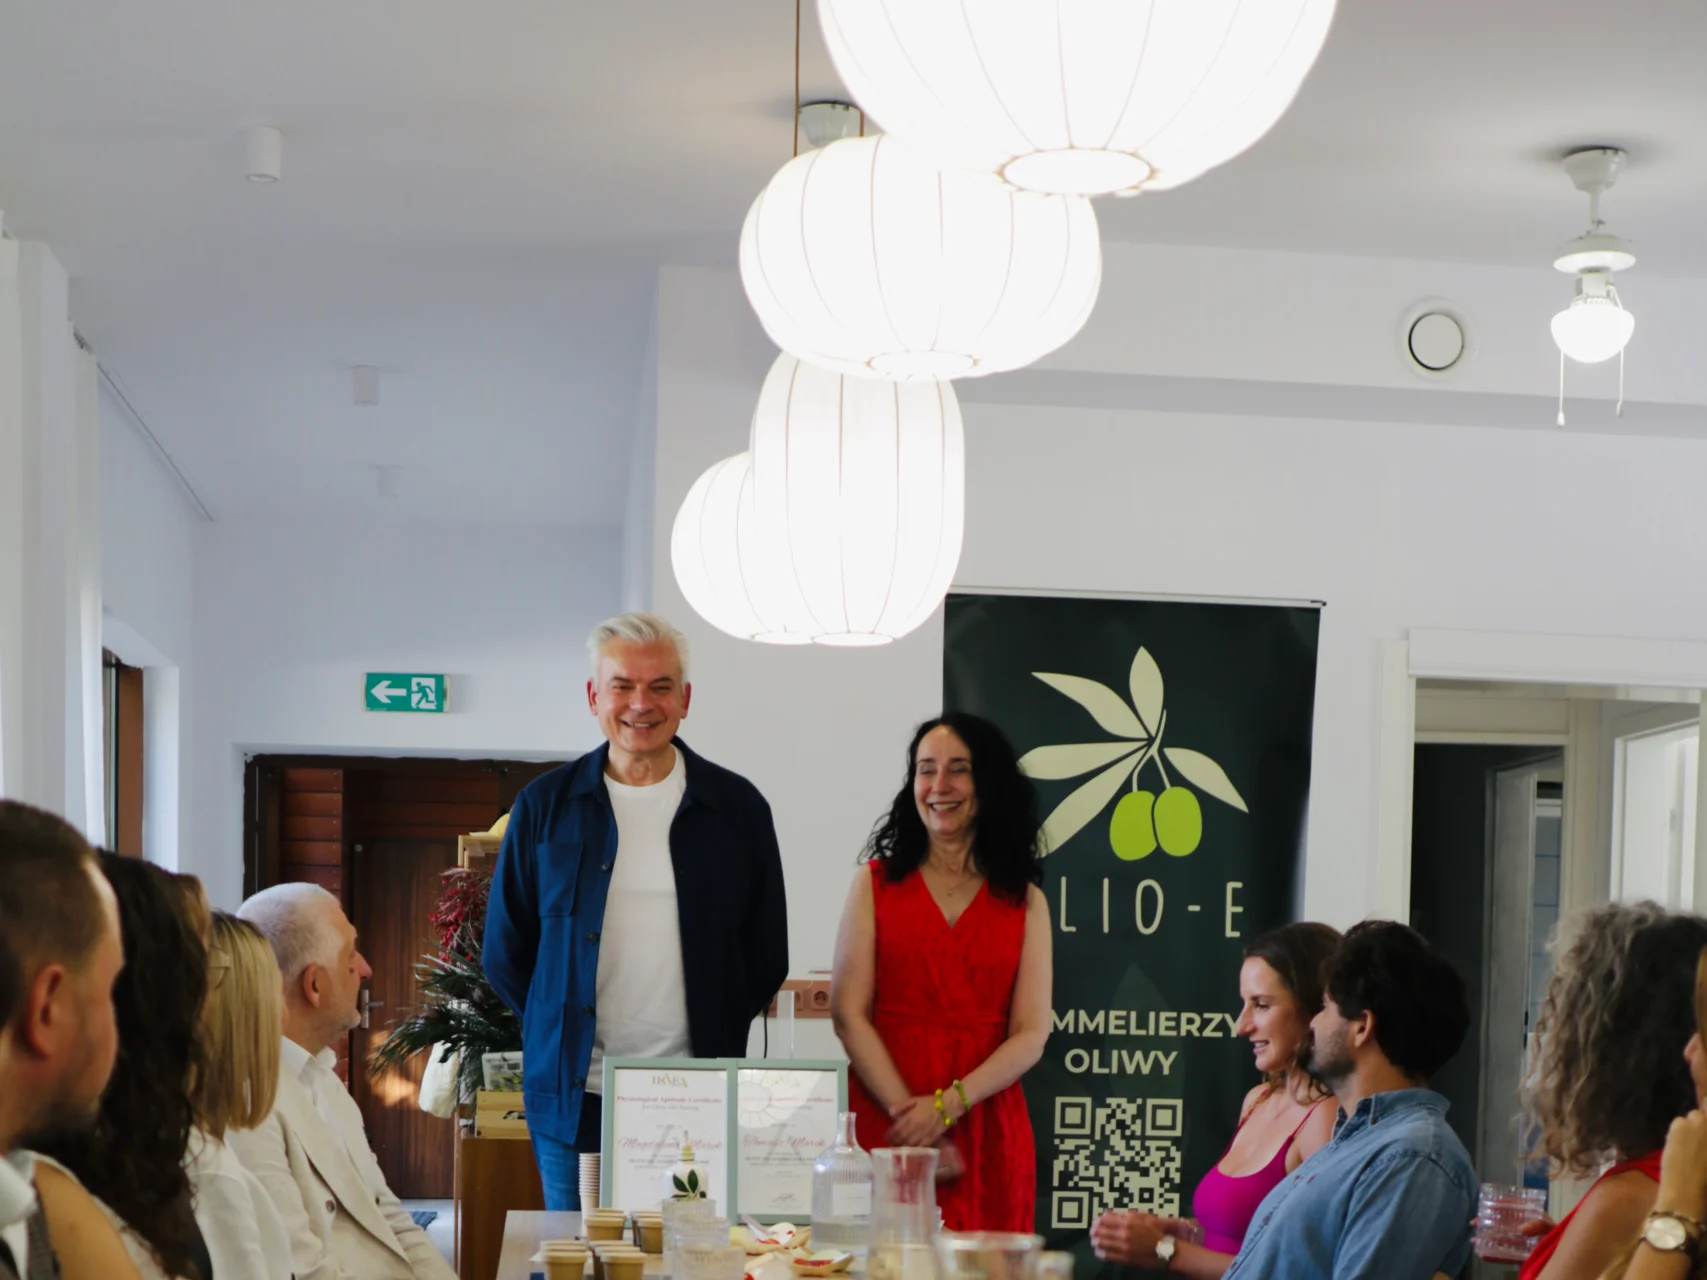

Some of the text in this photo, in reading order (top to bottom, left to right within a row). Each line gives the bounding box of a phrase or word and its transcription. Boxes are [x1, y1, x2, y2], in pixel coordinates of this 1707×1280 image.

[1059, 875, 1244, 939] LIO-E
[1050, 1008, 1239, 1038] MMELIERZY
[1063, 1047, 1179, 1076] OLIWY
